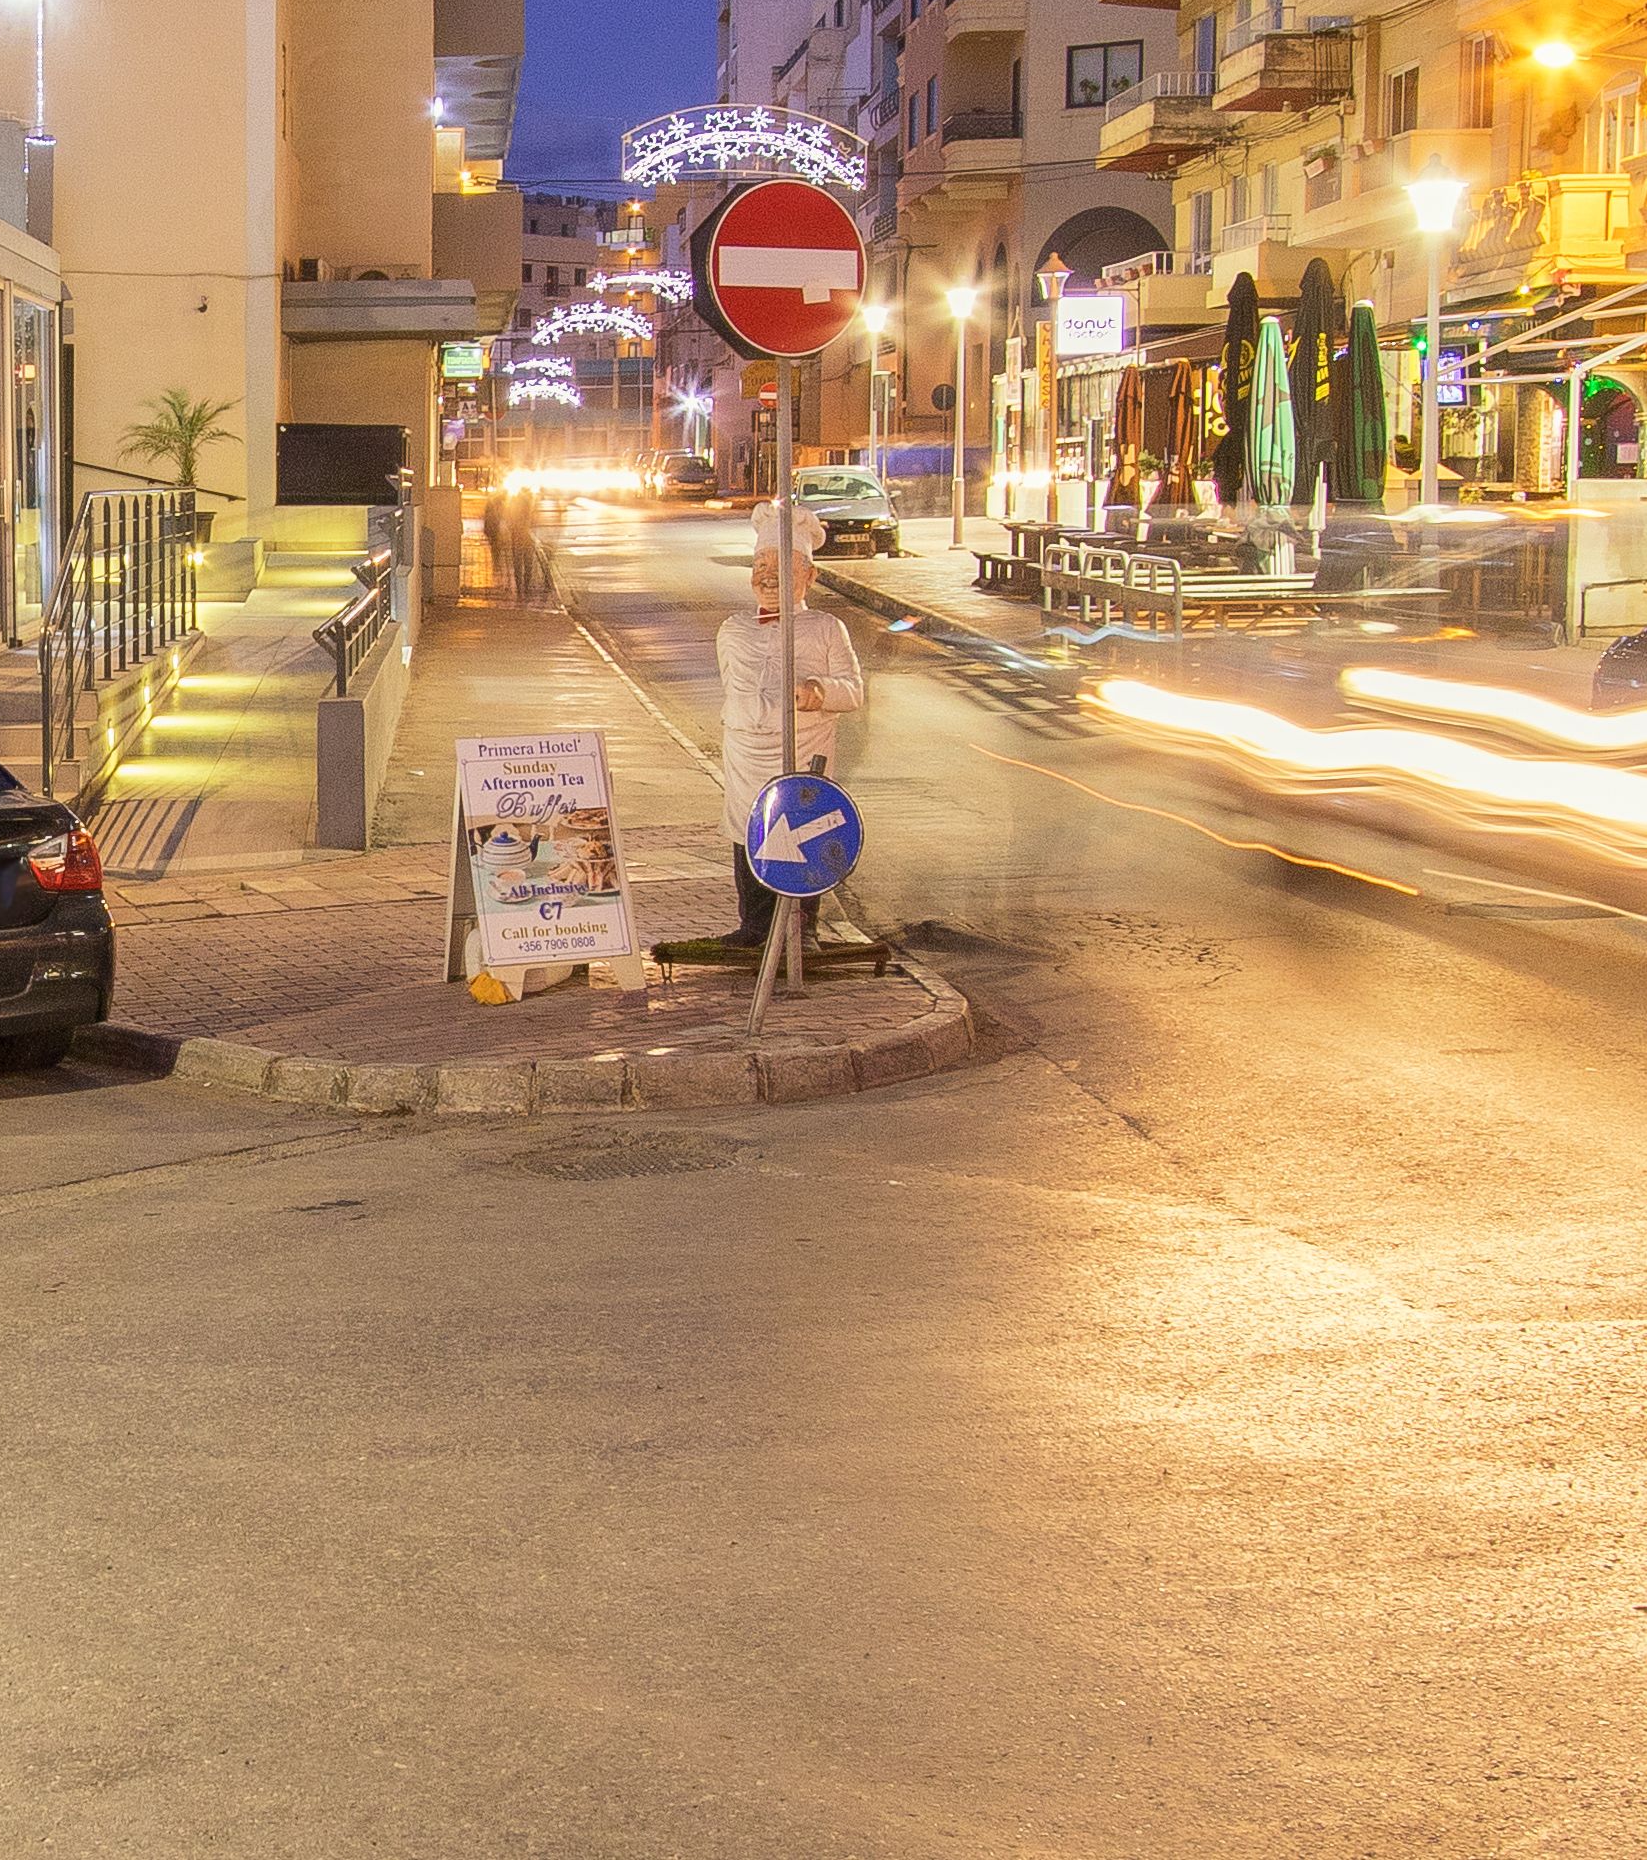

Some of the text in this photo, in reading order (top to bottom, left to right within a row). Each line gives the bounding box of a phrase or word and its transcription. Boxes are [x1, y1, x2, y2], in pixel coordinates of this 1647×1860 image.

[1063, 318, 1117, 330] donut
[478, 739, 578, 758] Primera Hotel
[503, 761, 557, 776] Sunday
[481, 773, 585, 792] Afternoon Tea
[539, 901, 563, 921] €7
[501, 921, 609, 940] Call for booking
[518, 936, 596, 952] +356 7906 0808
